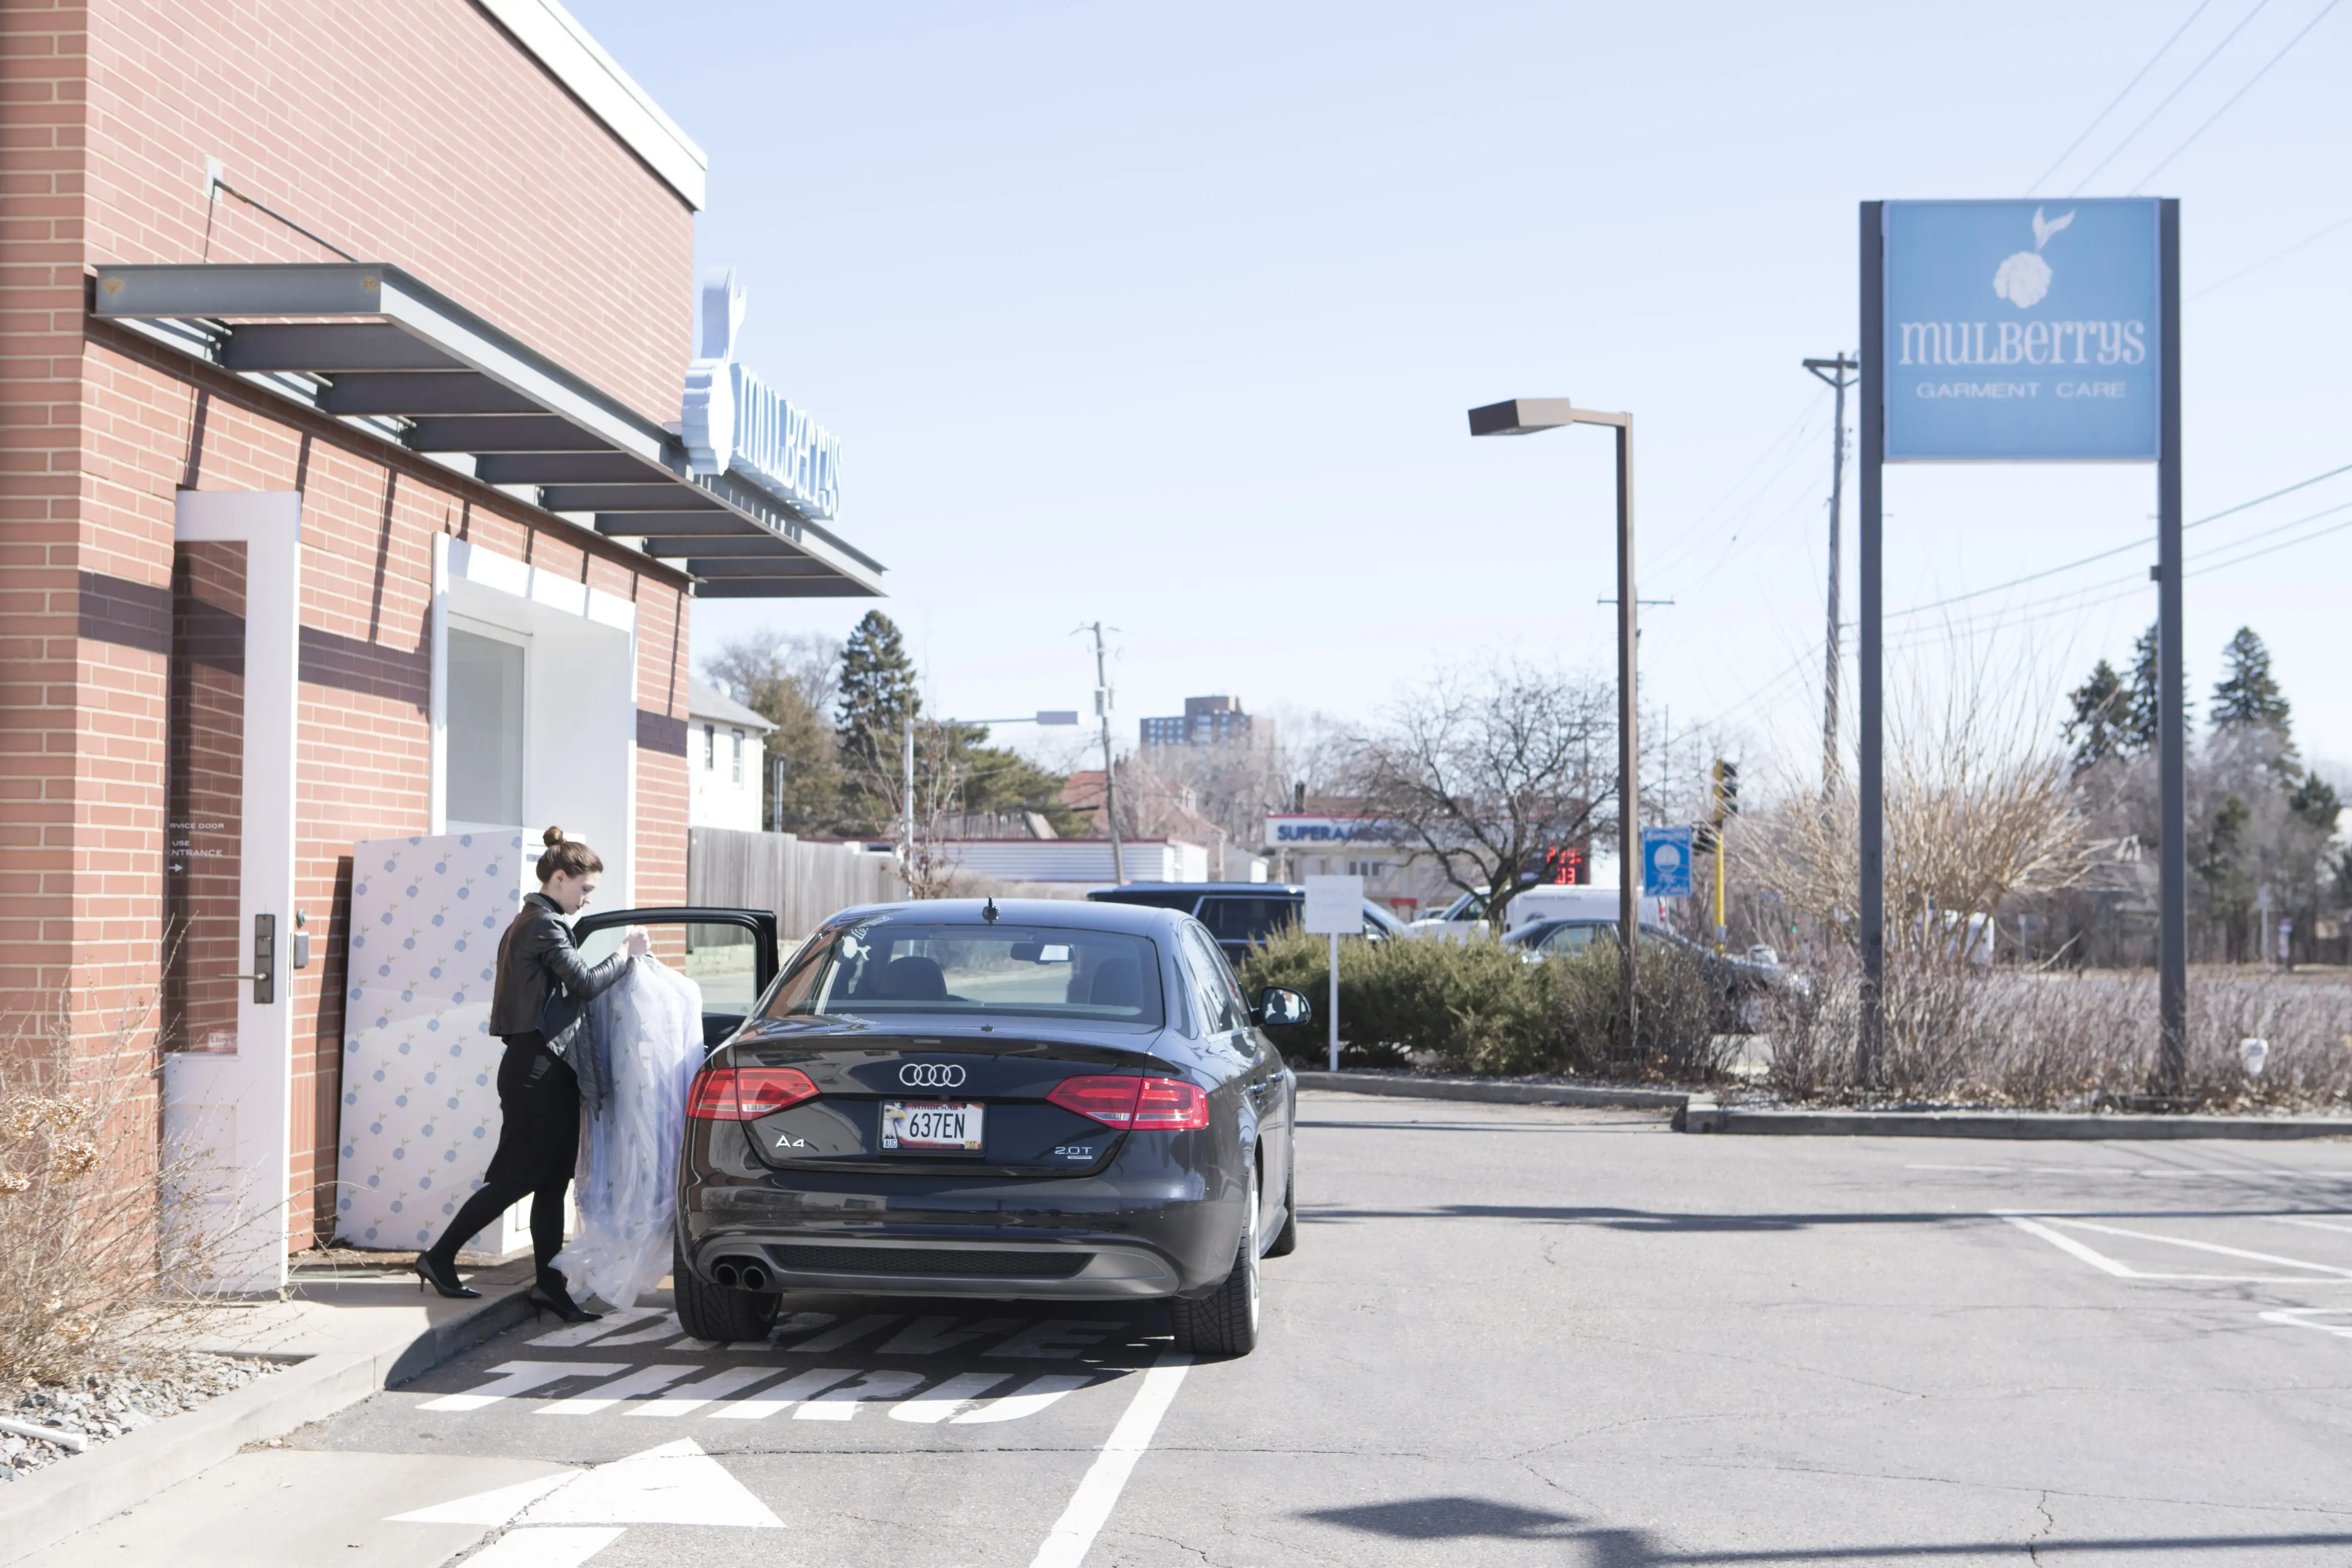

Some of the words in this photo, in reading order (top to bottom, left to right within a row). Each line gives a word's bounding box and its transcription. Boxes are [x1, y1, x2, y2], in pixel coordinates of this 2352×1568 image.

[1916, 382, 2041, 398] GARMENT
[2055, 382, 2126, 398] CARE
[910, 1113, 965, 1138] 637EN
[885, 1139, 897, 1148] AUG
[1055, 1146, 1092, 1155] 2.0T
[415, 1361, 1096, 1424] THRU
